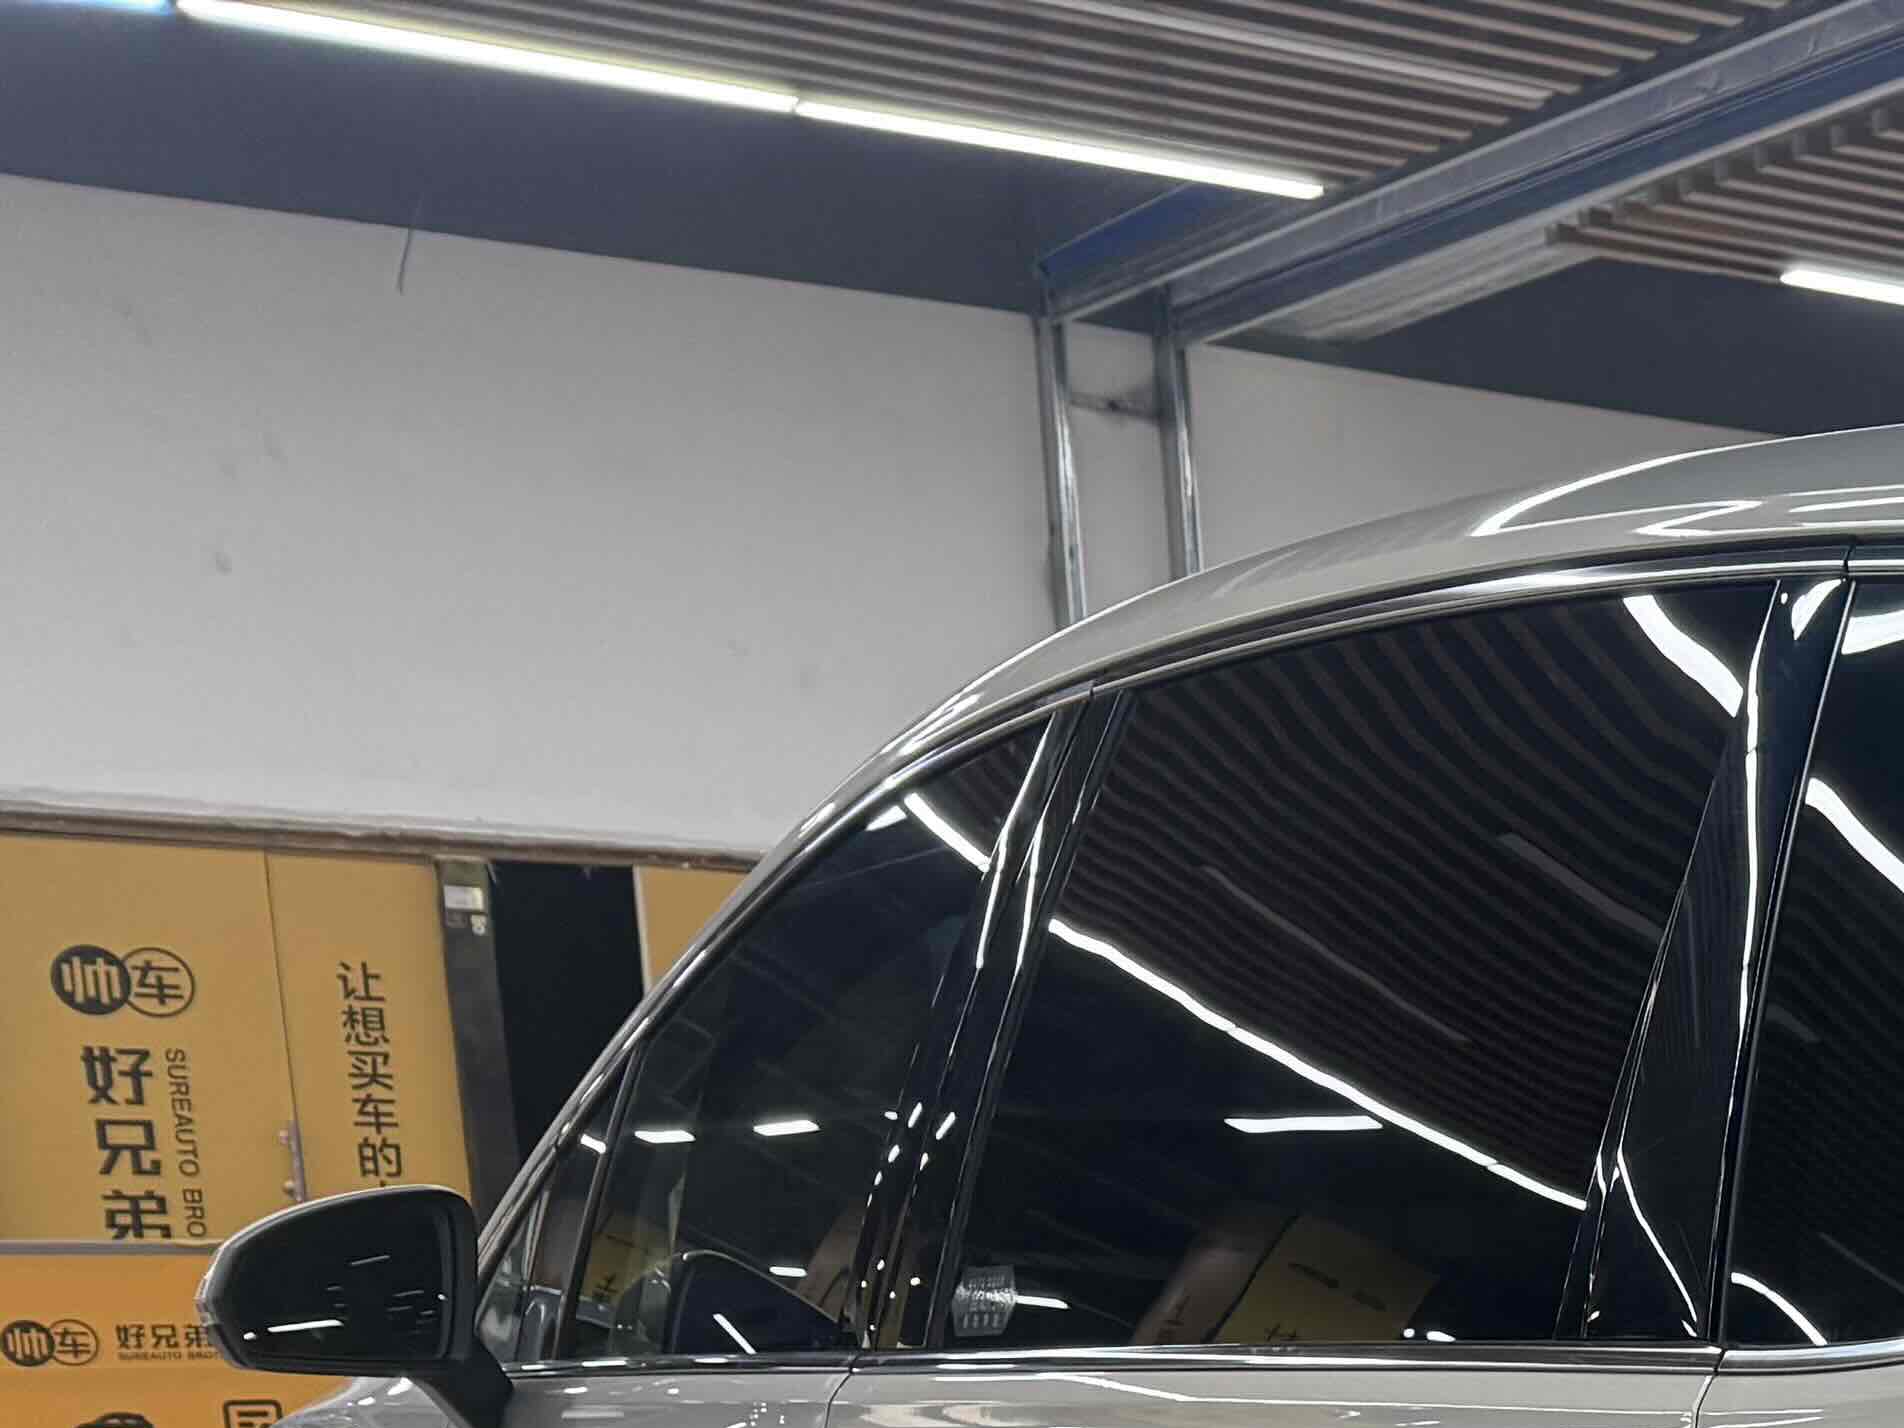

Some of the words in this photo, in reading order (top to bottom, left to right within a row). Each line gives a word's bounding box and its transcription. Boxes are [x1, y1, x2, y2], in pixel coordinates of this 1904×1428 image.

[51, 944, 195, 1018] 帅车
[80, 1046, 172, 1240] 好兄弟
[164, 1047, 201, 1178] SUREAUTO
